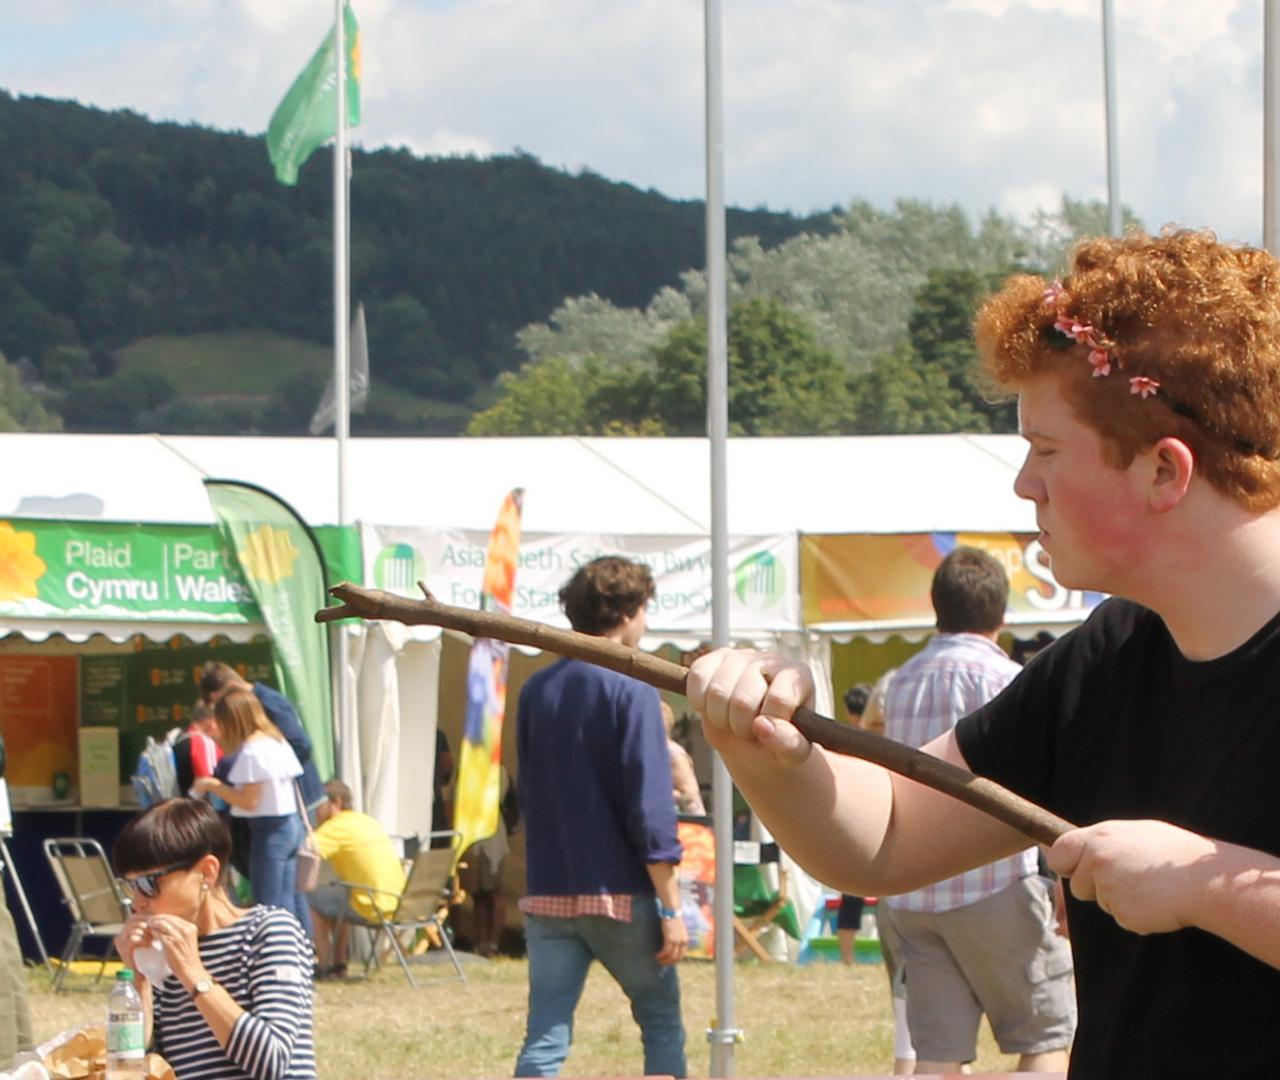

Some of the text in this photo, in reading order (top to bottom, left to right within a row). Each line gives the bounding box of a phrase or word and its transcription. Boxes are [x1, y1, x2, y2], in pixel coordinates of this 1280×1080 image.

[65, 540, 132, 567] Plaid
[66, 571, 159, 604] Cymru
[175, 574, 253, 603] Wales
